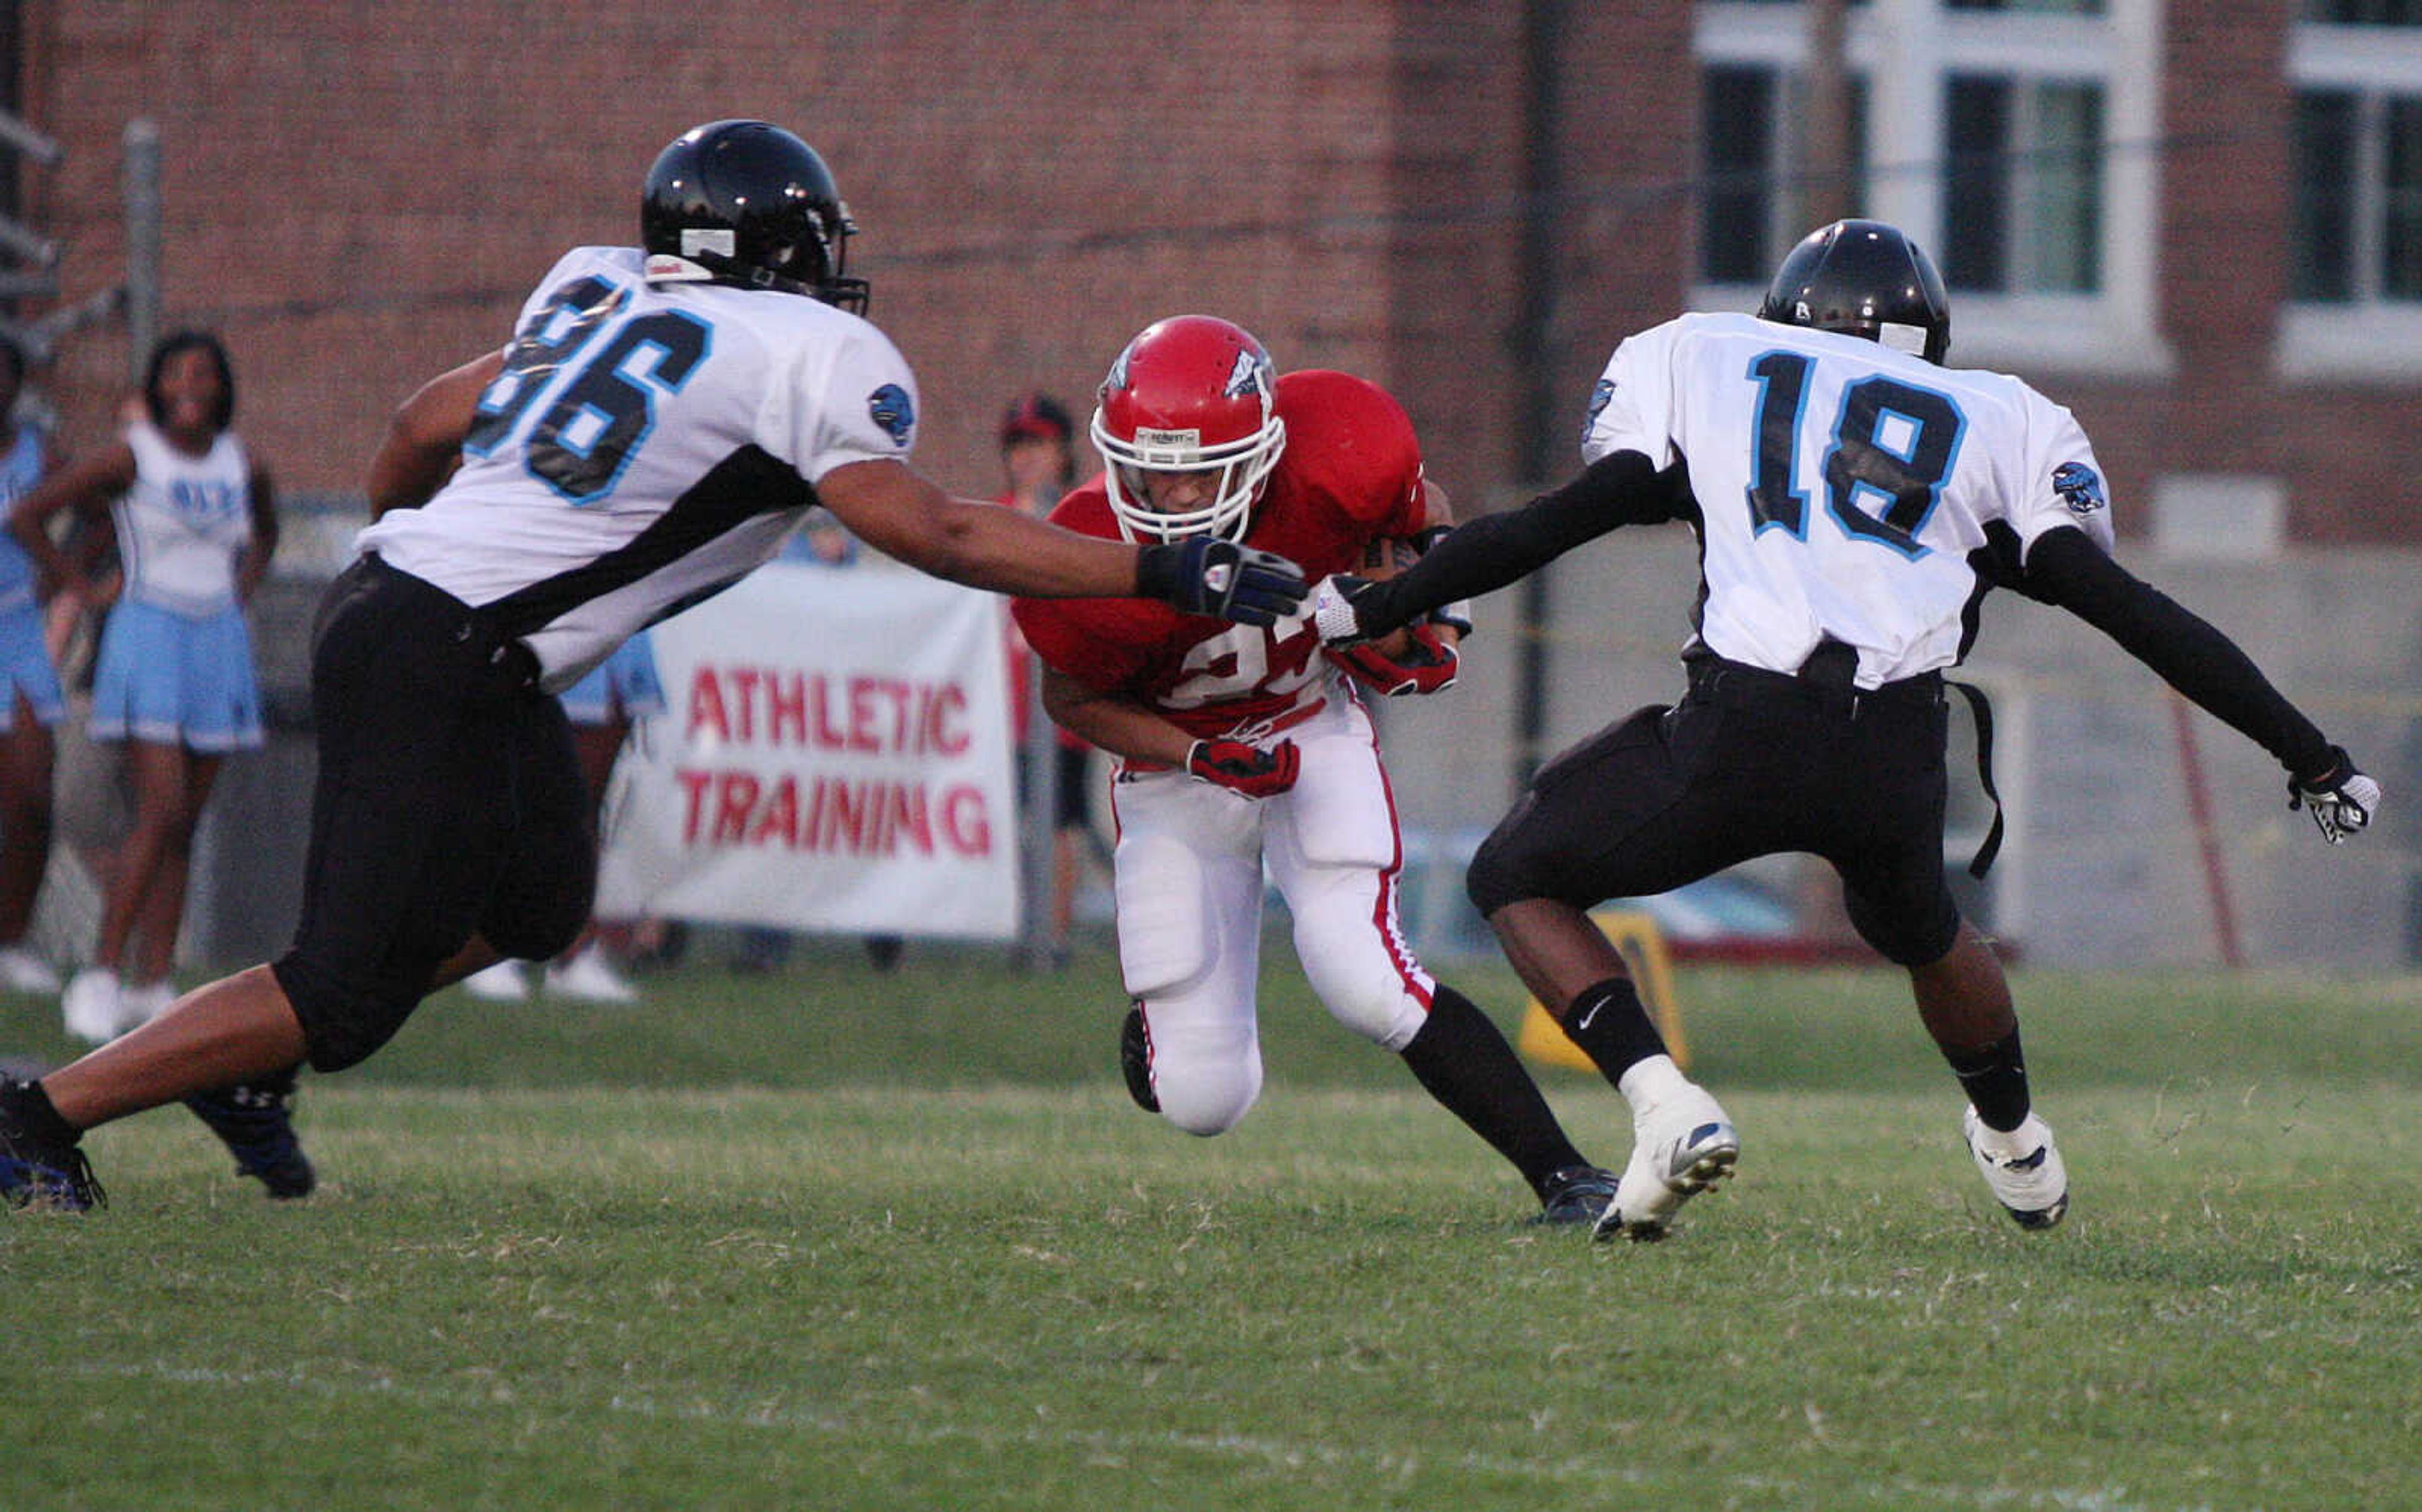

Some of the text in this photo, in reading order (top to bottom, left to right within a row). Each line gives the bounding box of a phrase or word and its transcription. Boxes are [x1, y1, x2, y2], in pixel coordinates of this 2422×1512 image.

[461, 274, 715, 506] 86
[1745, 349, 1969, 563] 18
[685, 666, 971, 758] ATHLETIC
[674, 767, 993, 859] TRAINING
